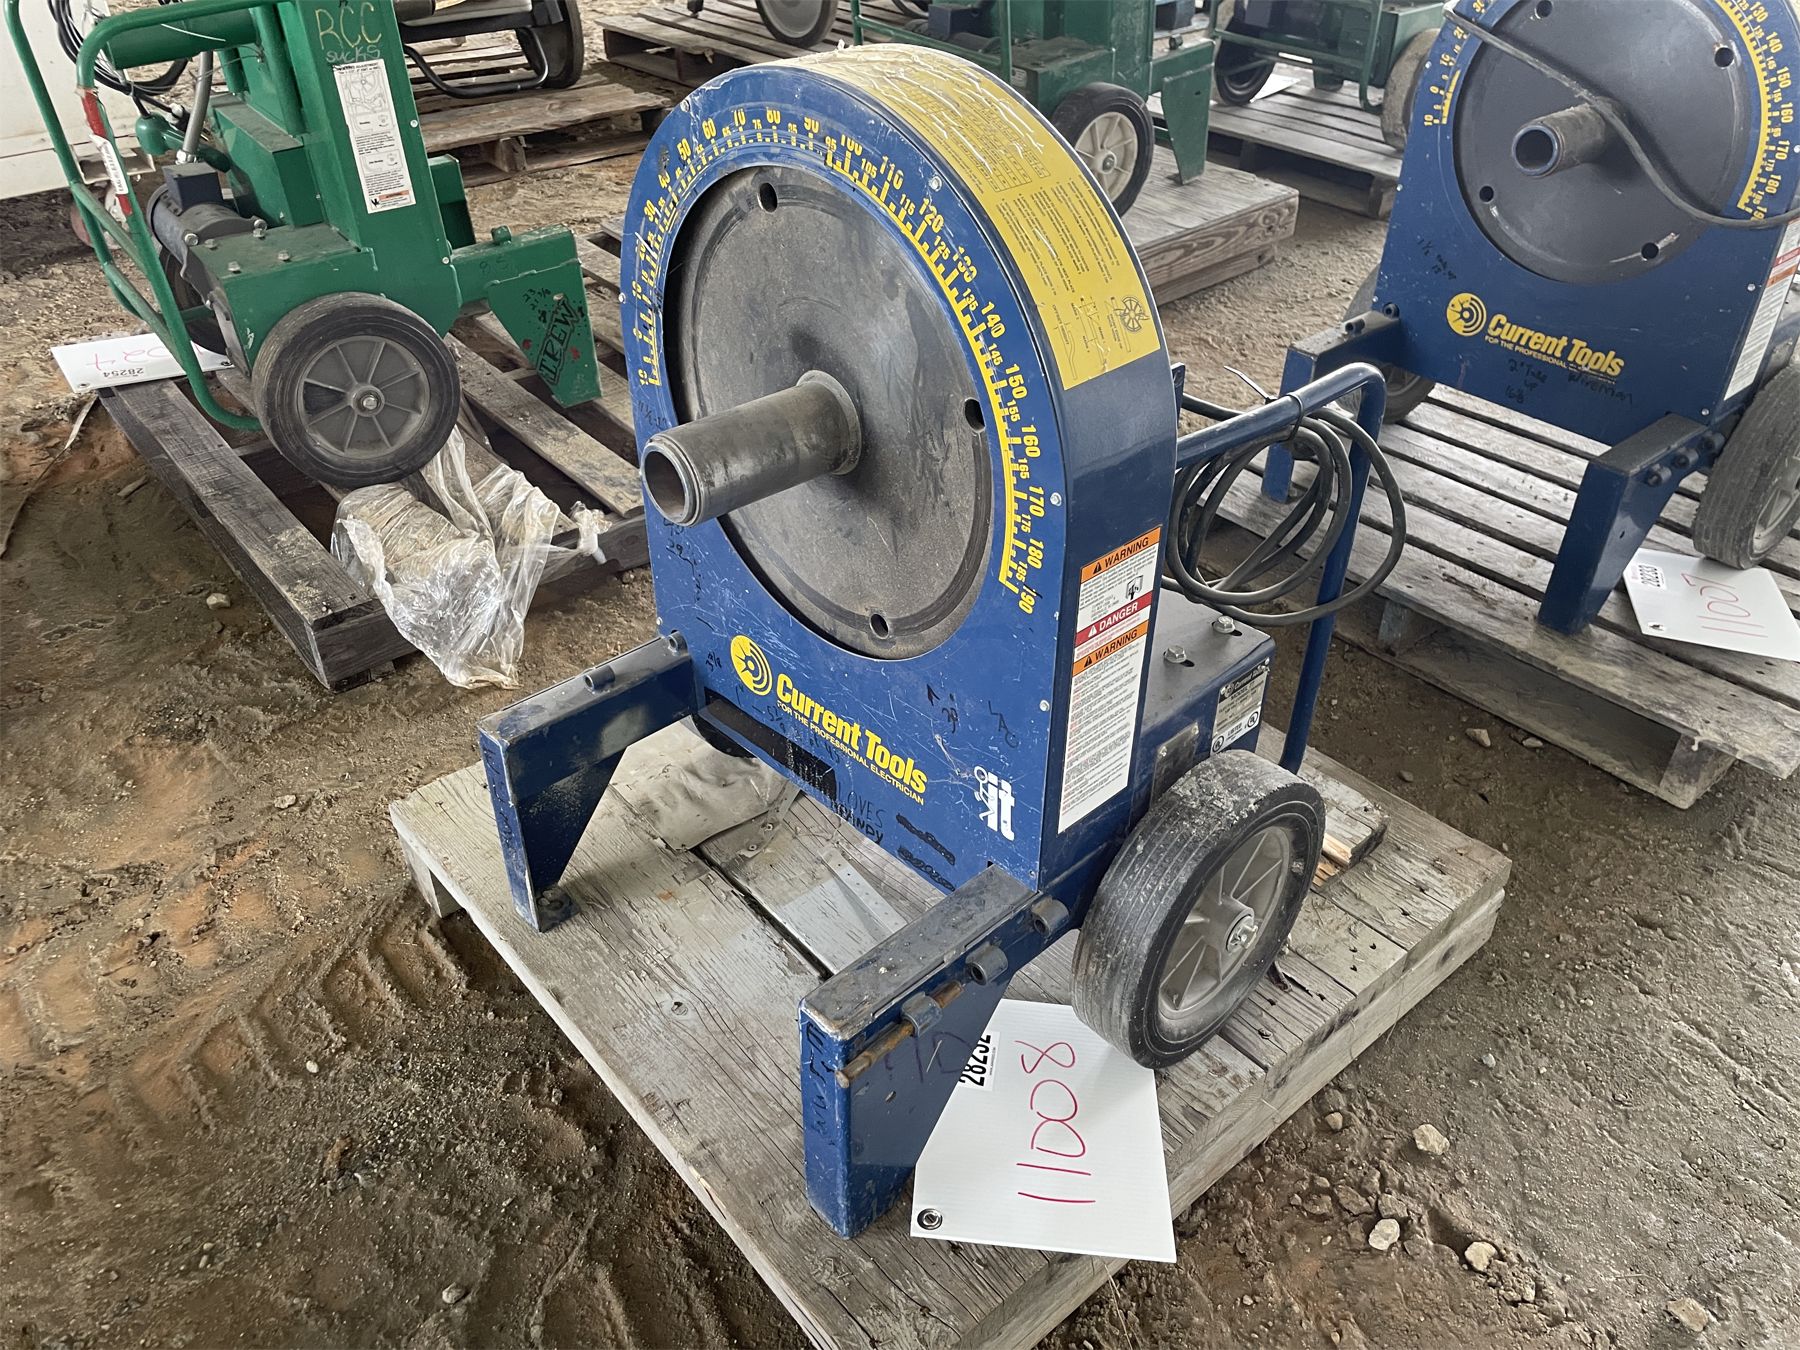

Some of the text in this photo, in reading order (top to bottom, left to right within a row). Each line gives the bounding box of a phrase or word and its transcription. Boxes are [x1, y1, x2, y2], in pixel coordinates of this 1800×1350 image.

[1750, 1, 1769, 23] 130
[315, 1, 382, 50] RCC
[1766, 32, 1783, 54] 140
[1776, 66, 1792, 89] 150
[752, 119, 762, 129] 75
[1424, 114, 1434, 126] 10
[1781, 102, 1794, 124] 160
[702, 118, 717, 140] 60
[677, 138, 692, 160] 50
[825, 135, 837, 152] 95
[1775, 140, 1790, 161] 170
[860, 157, 877, 178] 105
[880, 155, 904, 190] 110
[1765, 174, 1782, 194] 180
[644, 200, 656, 222] 30
[899, 193, 916, 215] 115
[919, 197, 944, 233] 120
[933, 235, 950, 260] 125
[952, 245, 978, 283] 130
[962, 288, 979, 311] 135
[981, 301, 1006, 338] 140
[988, 343, 1004, 366] 145
[1484, 335, 1567, 369] FOR THE PROFESSIONAL
[1487, 313, 1568, 358] Current
[1567, 338, 1625, 377] Tools
[103, 367, 144, 378] 28254
[1005, 363, 1028, 399] 150
[1006, 399, 1021, 422] 155
[1021, 424, 1041, 458] 160
[1017, 457, 1030, 480] 165
[1028, 485, 1045, 518] 170
[1020, 513, 1032, 534] 175
[1026, 538, 1044, 569] 180
[1104, 536, 1149, 568] WARNING
[1015, 561, 1028, 583] 185
[1018, 584, 1038, 614] 190
[1100, 602, 1139, 631] DANGER
[1095, 629, 1138, 660] WARNING
[776, 673, 862, 751] Current
[864, 730, 928, 794] Tools
[794, 710, 809, 726] THE
[809, 722, 870, 769] PROFESSIONAL
[870, 763, 924, 806] ELECTRICIAN
